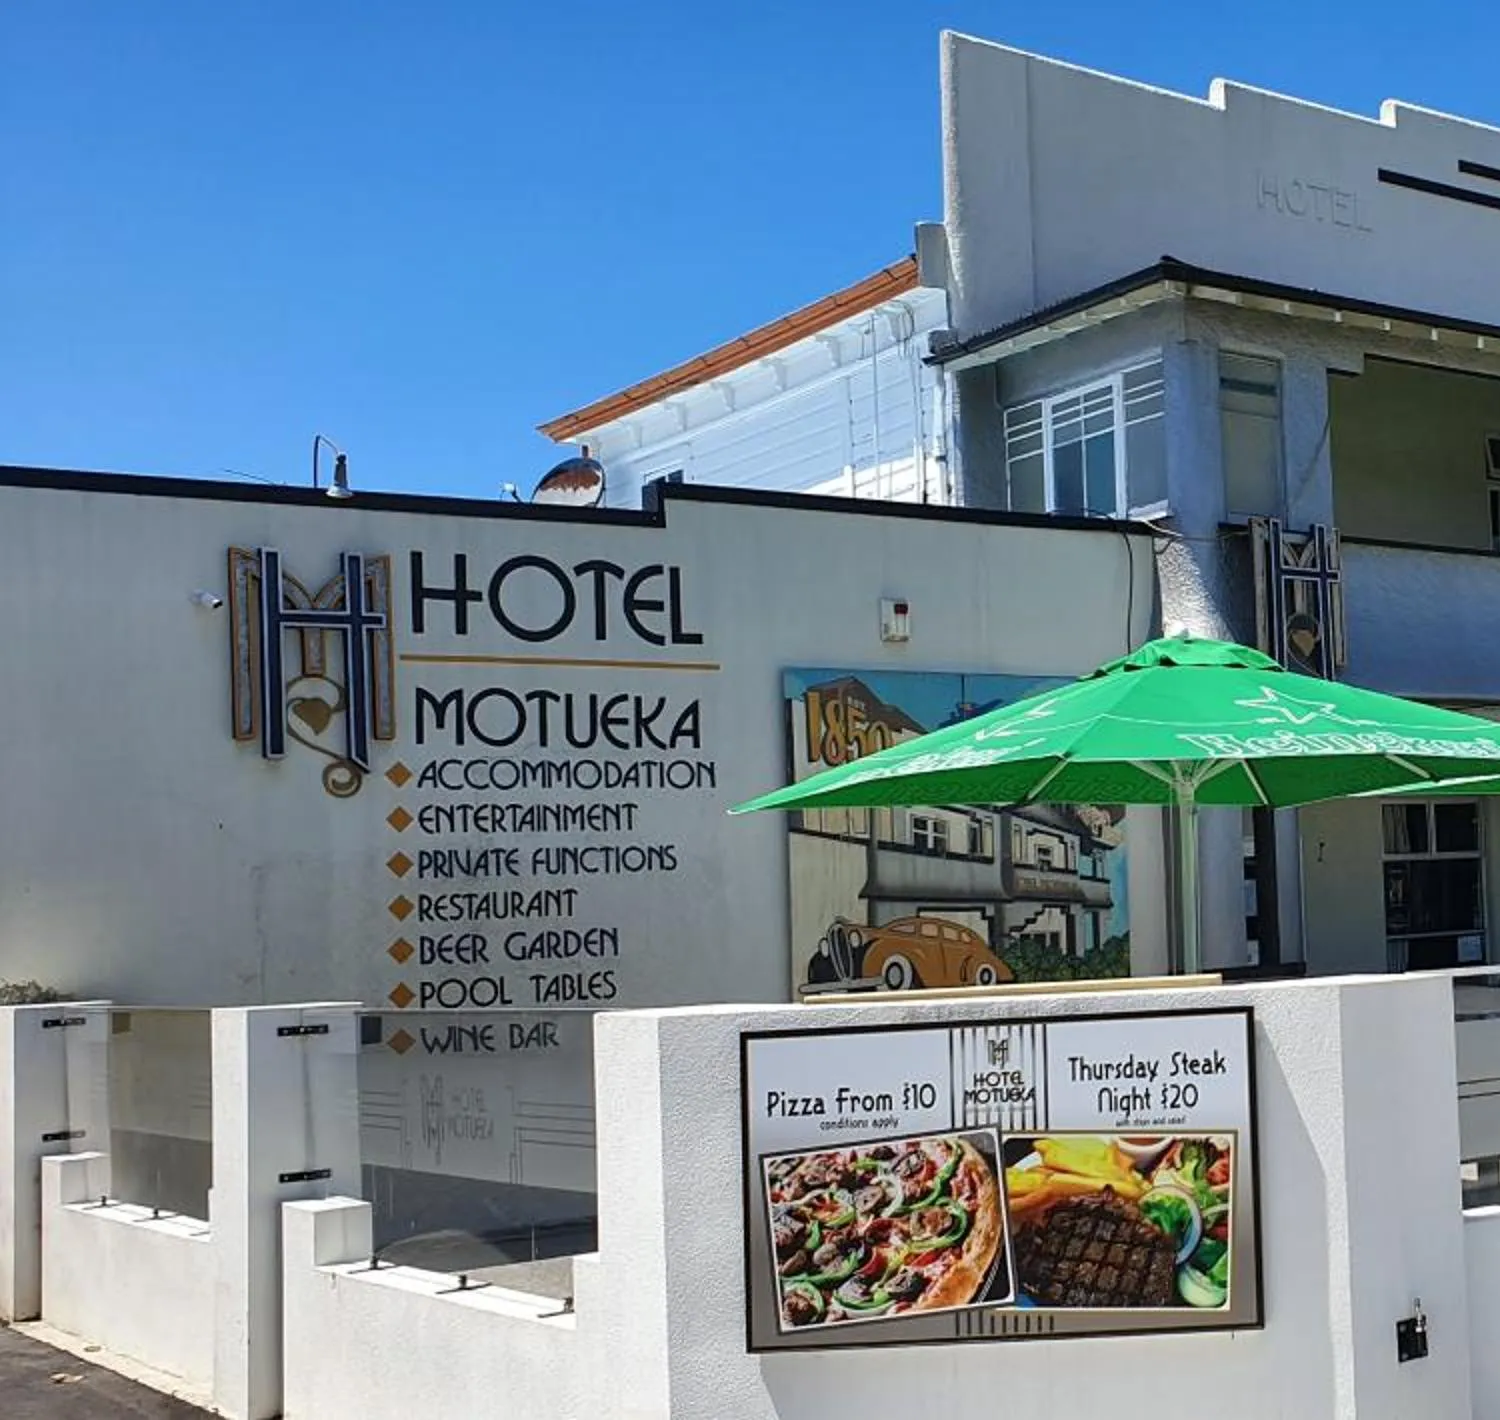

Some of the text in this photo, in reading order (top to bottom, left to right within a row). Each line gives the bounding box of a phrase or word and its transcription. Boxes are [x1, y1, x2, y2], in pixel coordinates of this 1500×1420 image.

[410, 551, 703, 646] HOTEL
[415, 688, 701, 750] MOTUEKA
[417, 759, 717, 790] ACCOMMODATION
[418, 803, 638, 834] ENTERTAINMENT
[418, 844, 677, 879] PRIVATE FUNCTIONS
[419, 889, 578, 922] RESTAURANT
[419, 928, 619, 965] BEER GARDEN
[420, 971, 617, 1009] POOL TABLES
[421, 1021, 561, 1055] WINE BAR
[973, 1069, 1024, 1087] HOTEL
[1067, 1049, 1227, 1082] Thursday Steak
[767, 1081, 937, 1118] Pizza From $10
[963, 1086, 1036, 1105] MOTUEKA
[1097, 1083, 1199, 1119] Night $20
[819, 1115, 900, 1131] conditions apply
